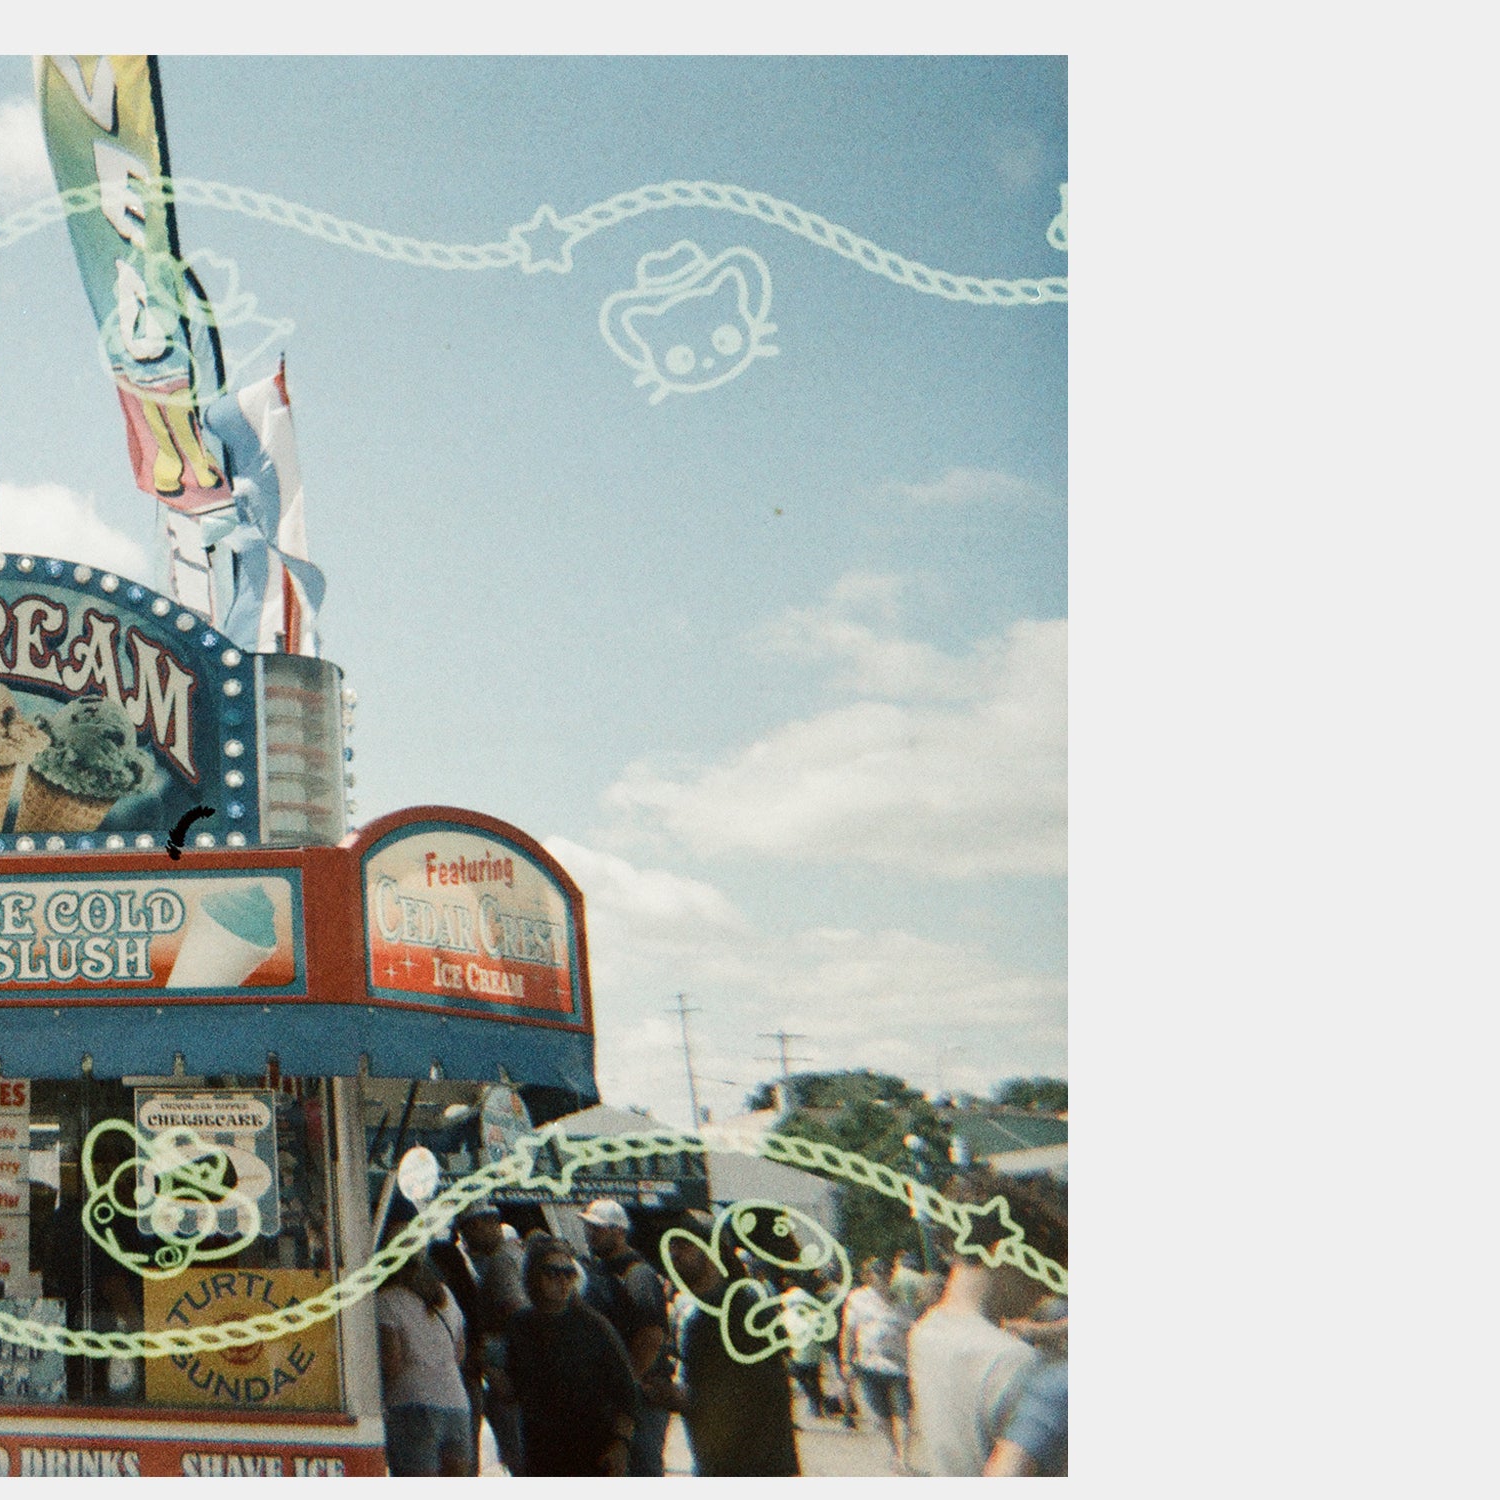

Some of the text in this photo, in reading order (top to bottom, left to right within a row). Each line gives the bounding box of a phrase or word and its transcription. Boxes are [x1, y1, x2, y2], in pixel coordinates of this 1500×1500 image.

[425, 851, 514, 889] Featuring
[45, 887, 186, 936] COLD
[432, 957, 525, 999] ICE CREAM
[147, 1113, 263, 1127] CHEESECAKE
[19, 1445, 140, 1477] DRINKS
